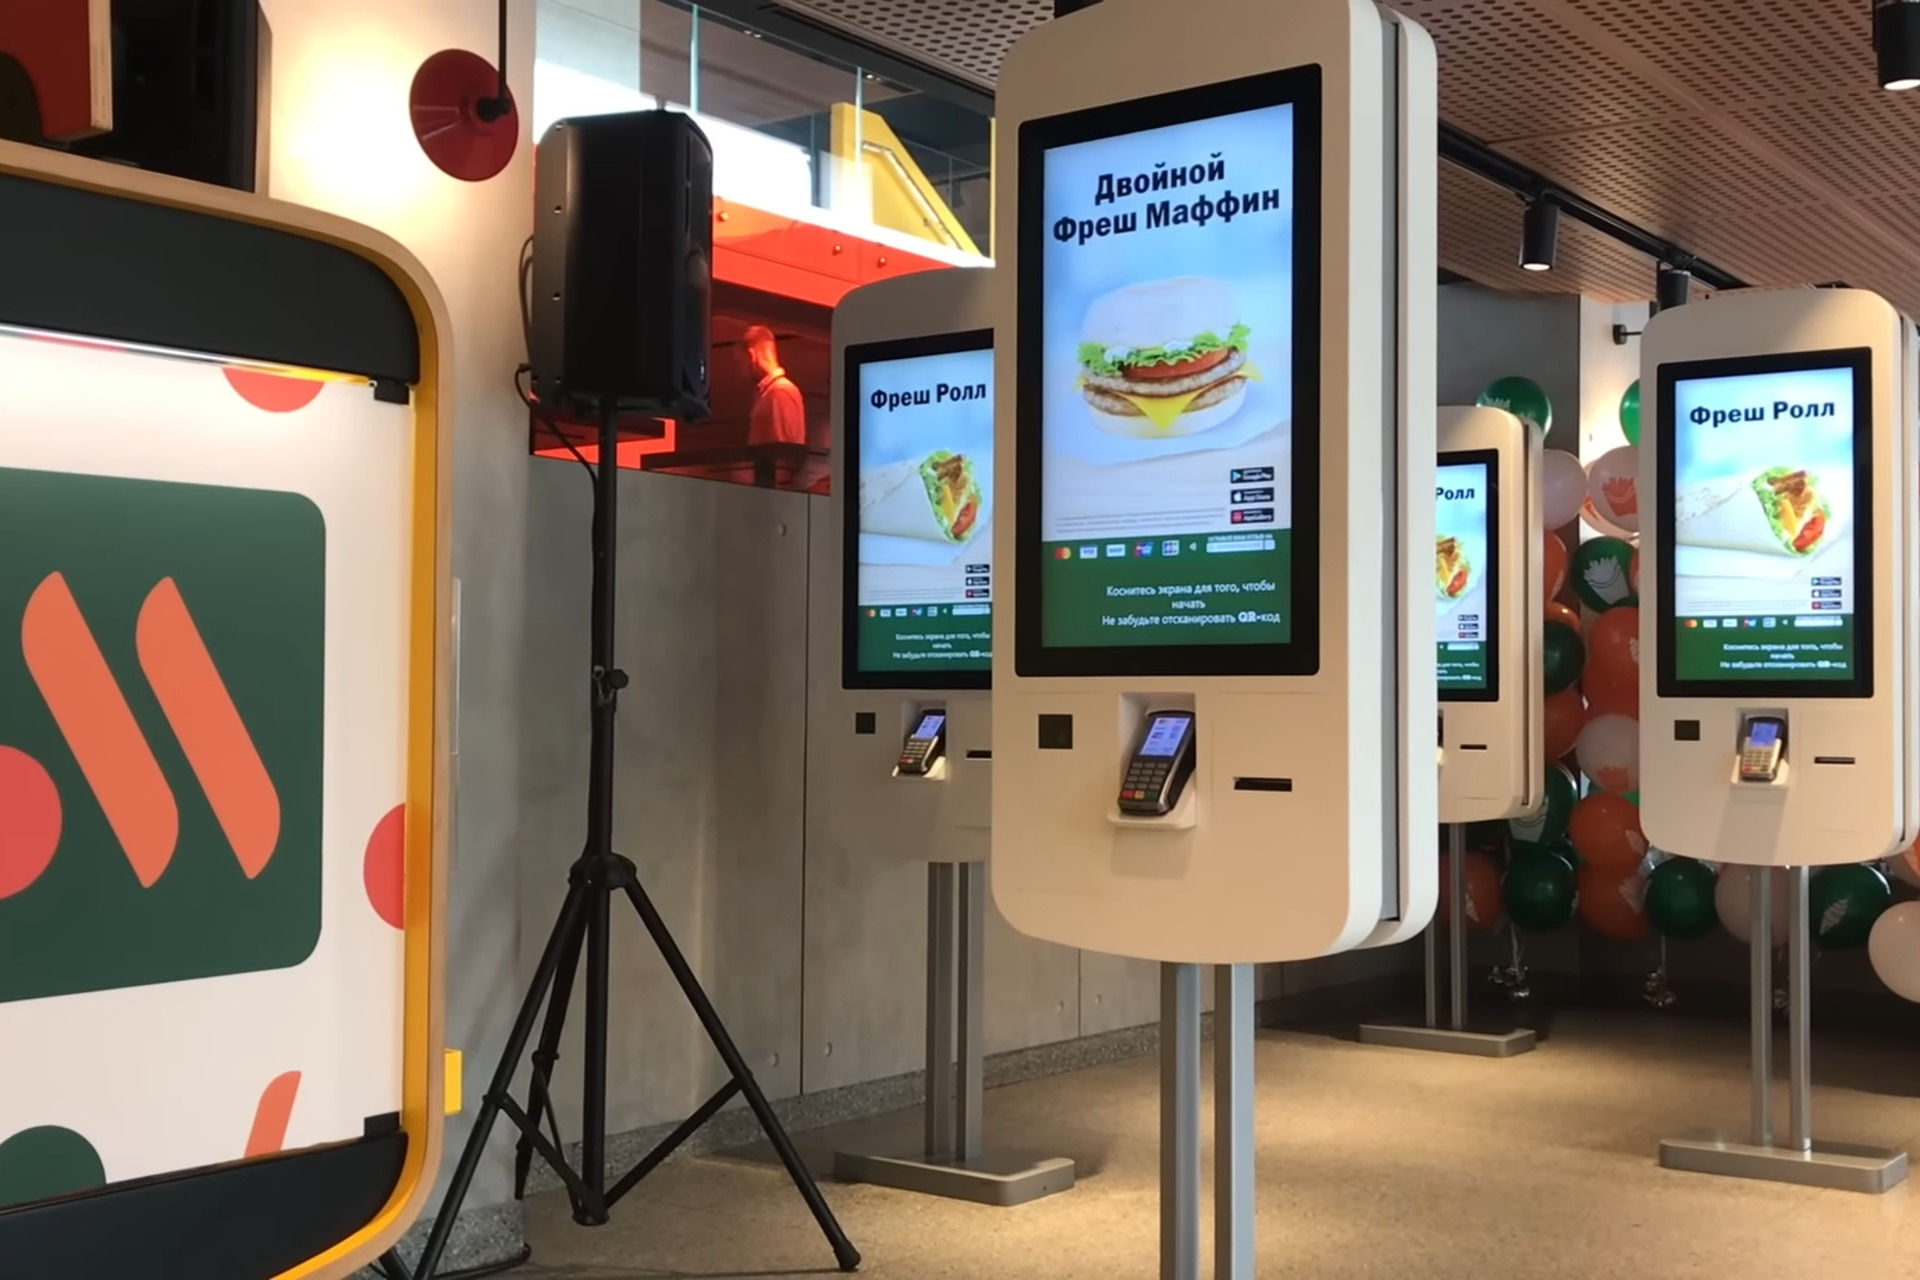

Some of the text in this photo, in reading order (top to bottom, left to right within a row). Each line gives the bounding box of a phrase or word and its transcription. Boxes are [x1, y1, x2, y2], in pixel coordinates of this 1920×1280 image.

[1095, 152, 1225, 206] Двойной
[1053, 189, 1279, 246] Фреш Маффин
[870, 383, 986, 412] Фреш Ролл
[1690, 401, 1835, 428] Фреш Ролл
[1436, 487, 1475, 500] Ролл
[1106, 580, 1275, 597] Коснитесь экрана для того, чтобы
[1172, 600, 1206, 610] начать
[1102, 611, 1280, 628] Не забудьте отсканировать QR-код
